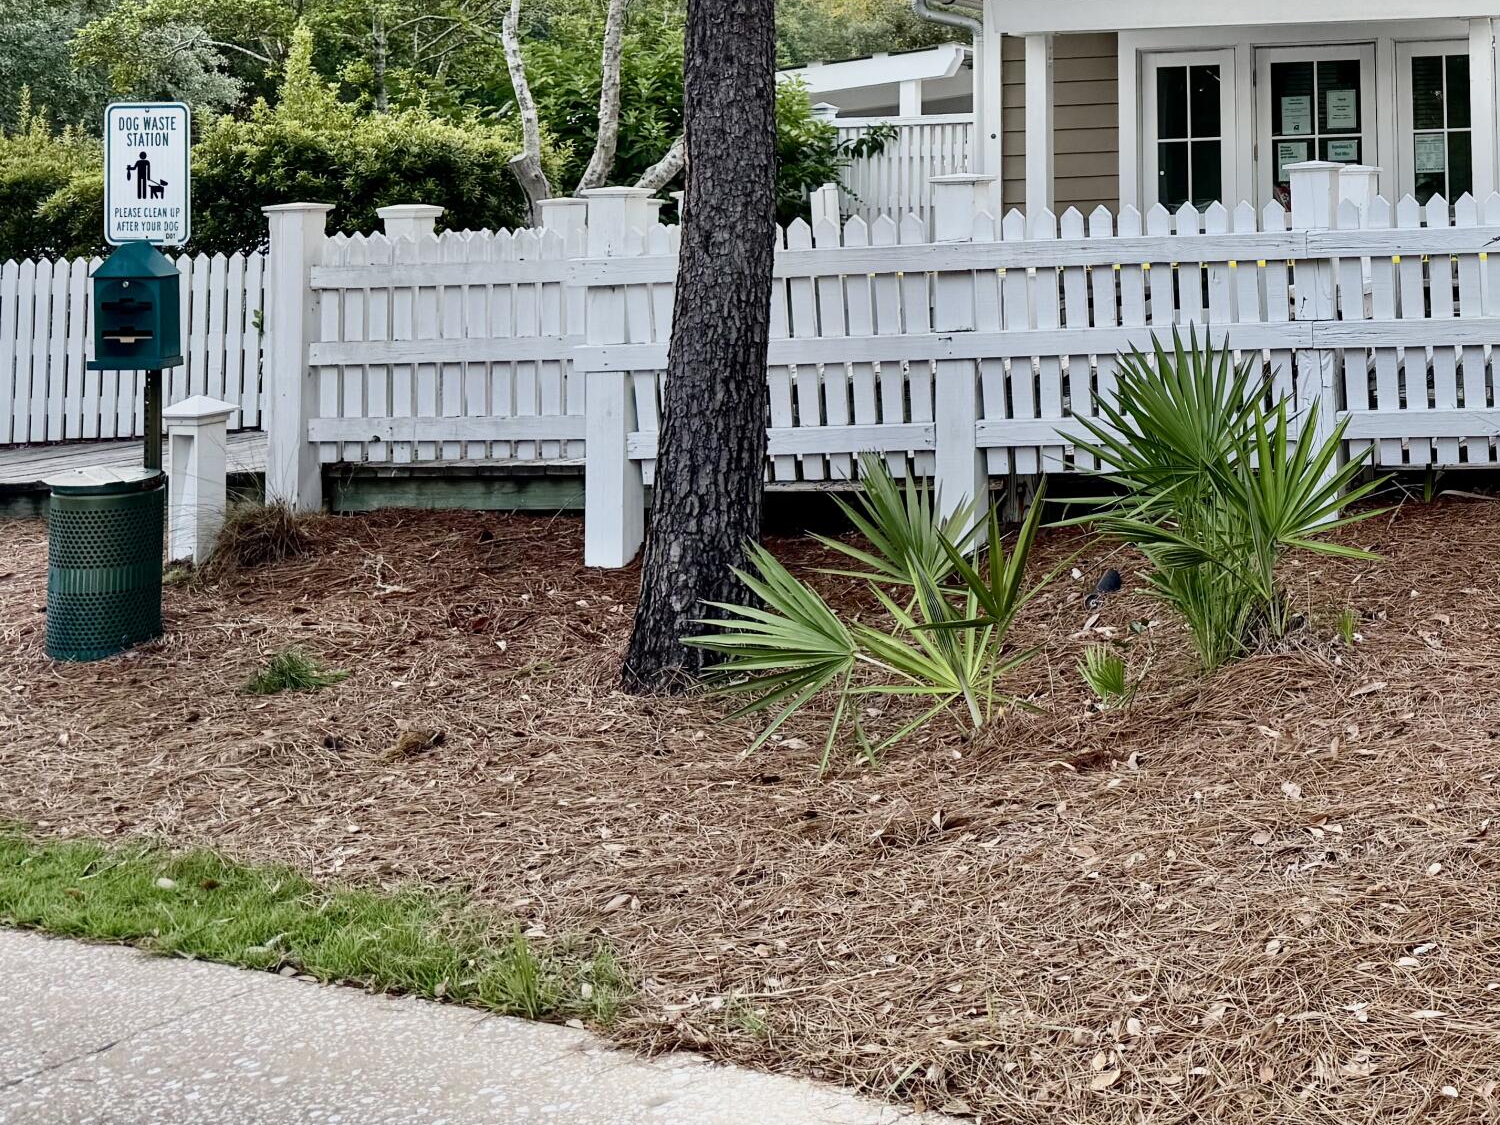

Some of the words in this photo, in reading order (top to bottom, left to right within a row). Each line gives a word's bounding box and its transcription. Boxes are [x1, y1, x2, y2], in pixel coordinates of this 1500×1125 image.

[118, 116, 139, 131] DOG
[143, 116, 177, 131] WASTE
[126, 132, 169, 147] STATION
[114, 207, 142, 218] PLEASE
[143, 207, 168, 218] CLEAN
[170, 207, 181, 218] UP
[116, 221, 139, 232] AFTER
[141, 221, 162, 232] YOUR
[163, 221, 179, 232] DOG
